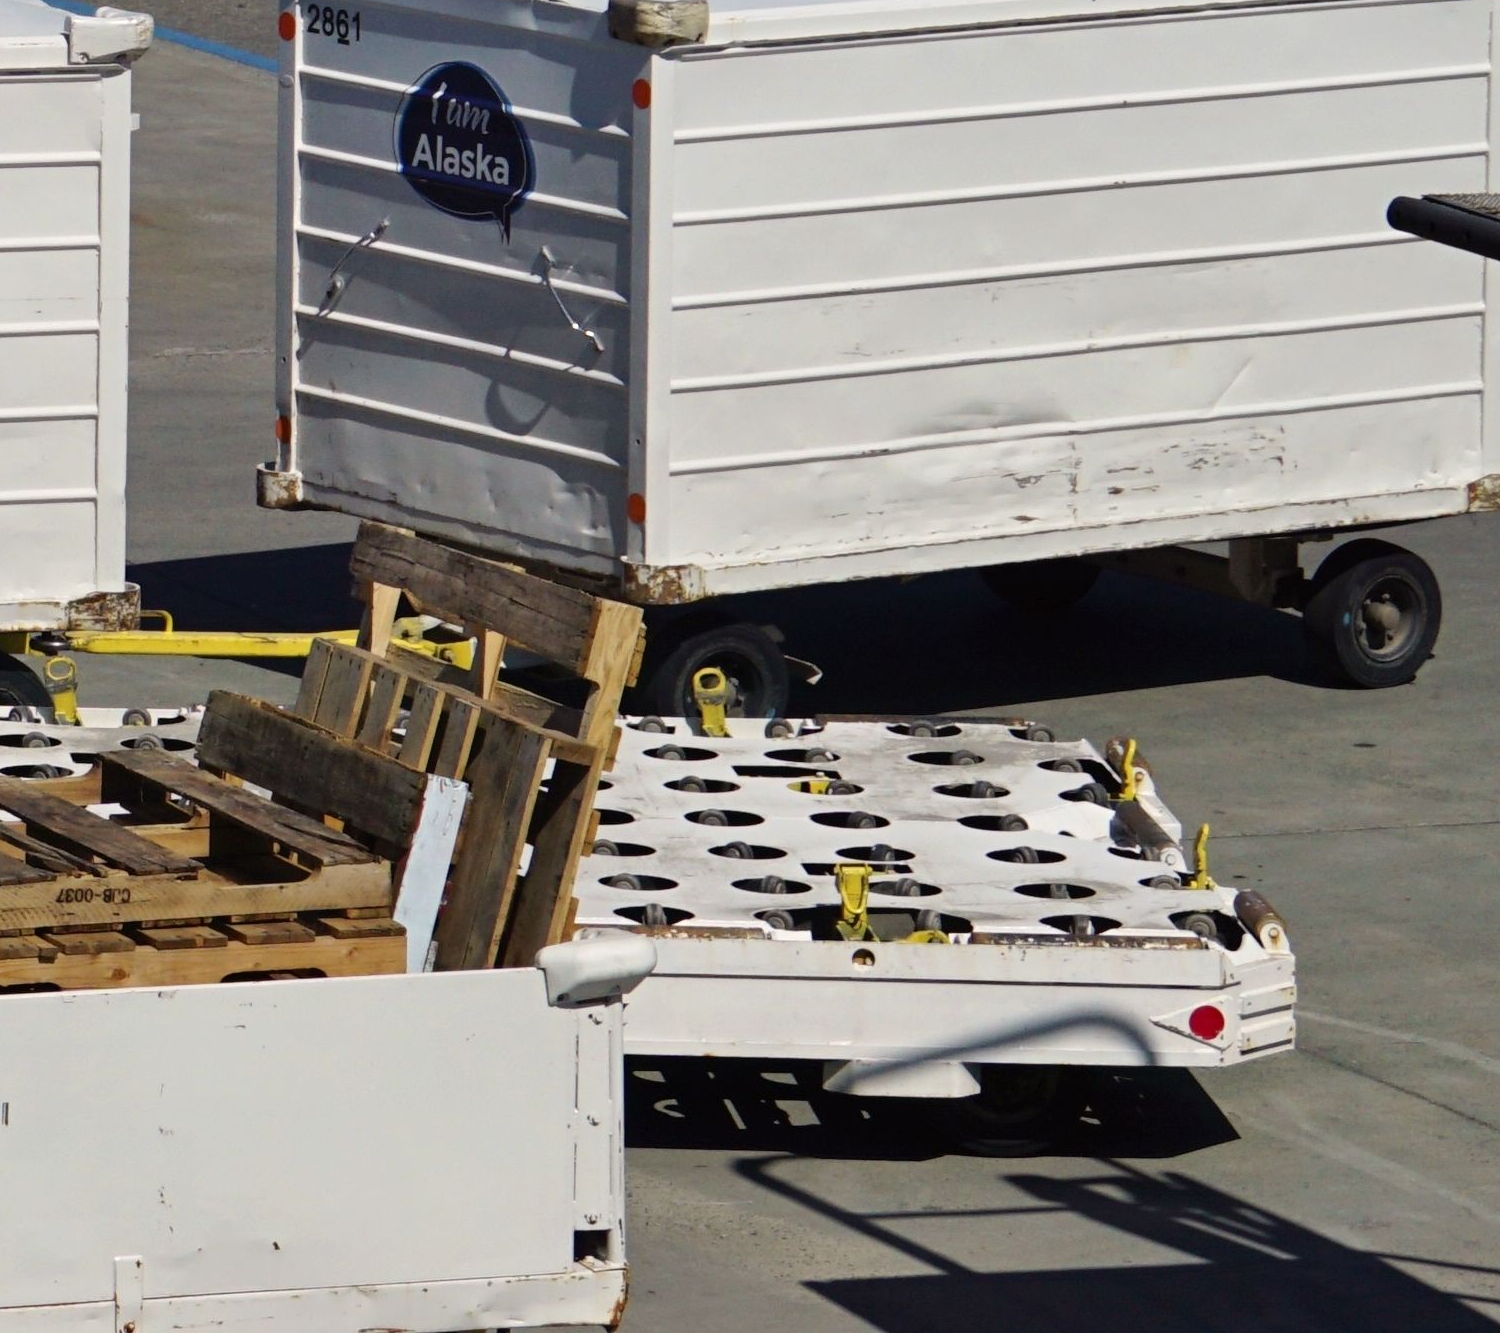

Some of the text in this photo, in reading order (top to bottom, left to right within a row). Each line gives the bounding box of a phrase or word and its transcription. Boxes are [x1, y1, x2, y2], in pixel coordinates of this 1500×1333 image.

[306, 3, 362, 45] 2861
[445, 95, 491, 135] am
[410, 133, 510, 193] Alaska
